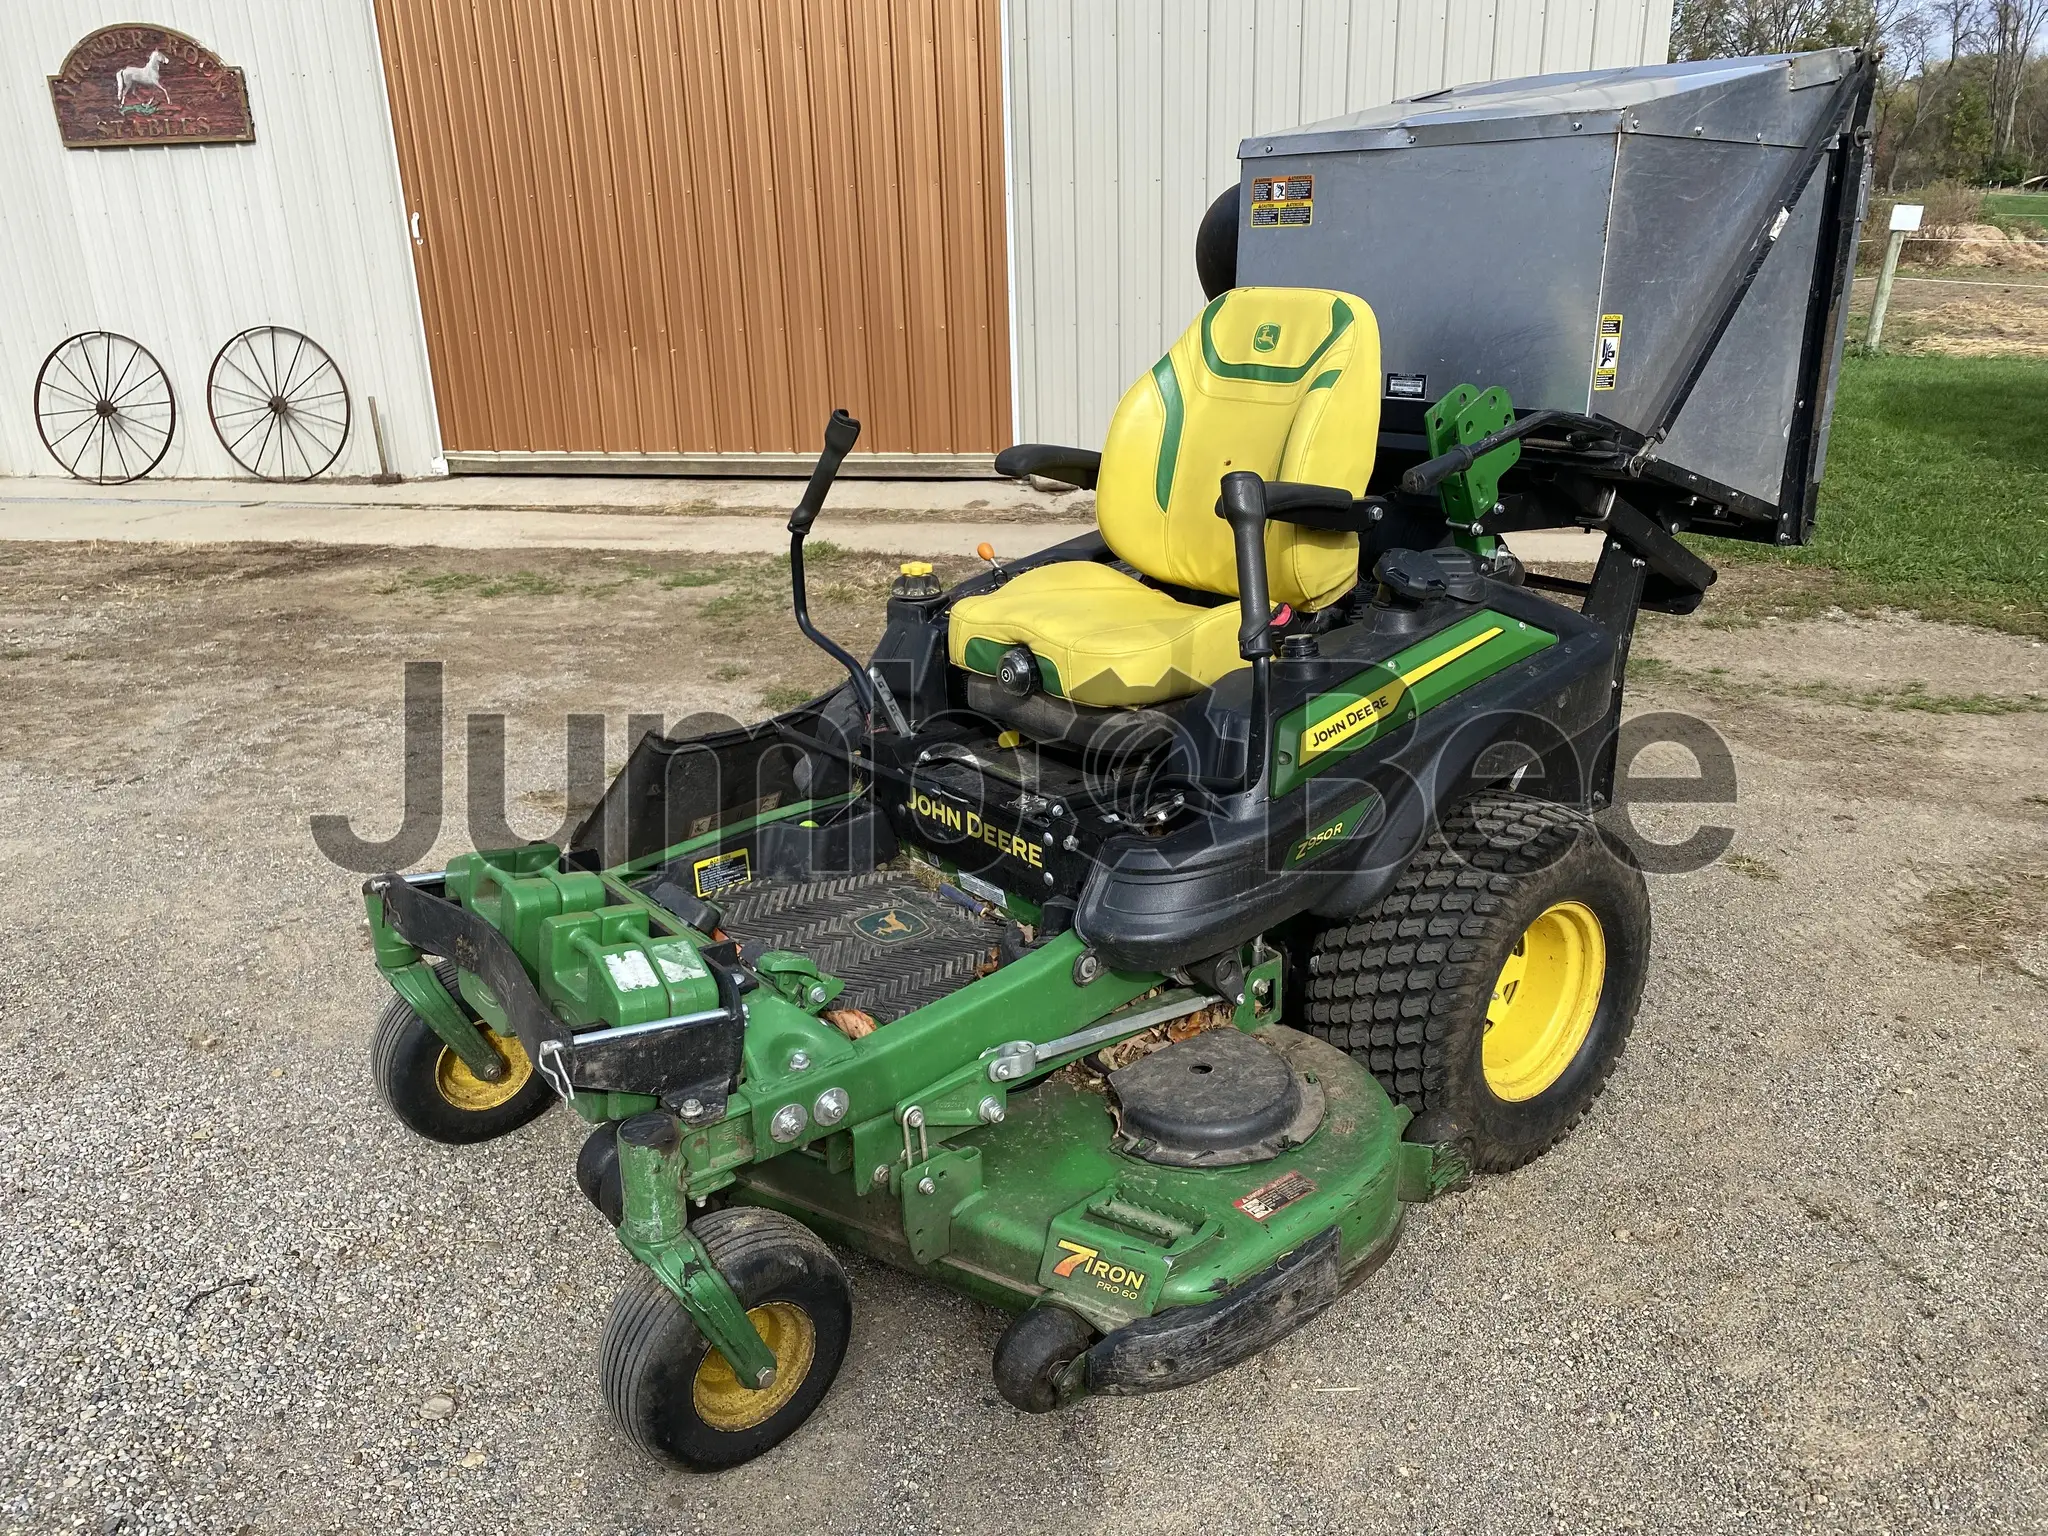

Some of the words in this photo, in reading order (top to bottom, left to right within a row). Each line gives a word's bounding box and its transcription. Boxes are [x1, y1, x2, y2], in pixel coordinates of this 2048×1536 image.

[59, 31, 145, 97] THUNDER
[166, 33, 226, 93] ROCK
[96, 116, 211, 138] STABLES
[1313, 721, 1347, 747] JOHN
[1346, 695, 1389, 727] DEERE
[907, 787, 961, 832] JOHN
[966, 811, 1043, 868] DEERE
[1295, 822, 1343, 861] Z950R
[1096, 1280, 1120, 1295] PRO
[1121, 1288, 1138, 1300] 60
